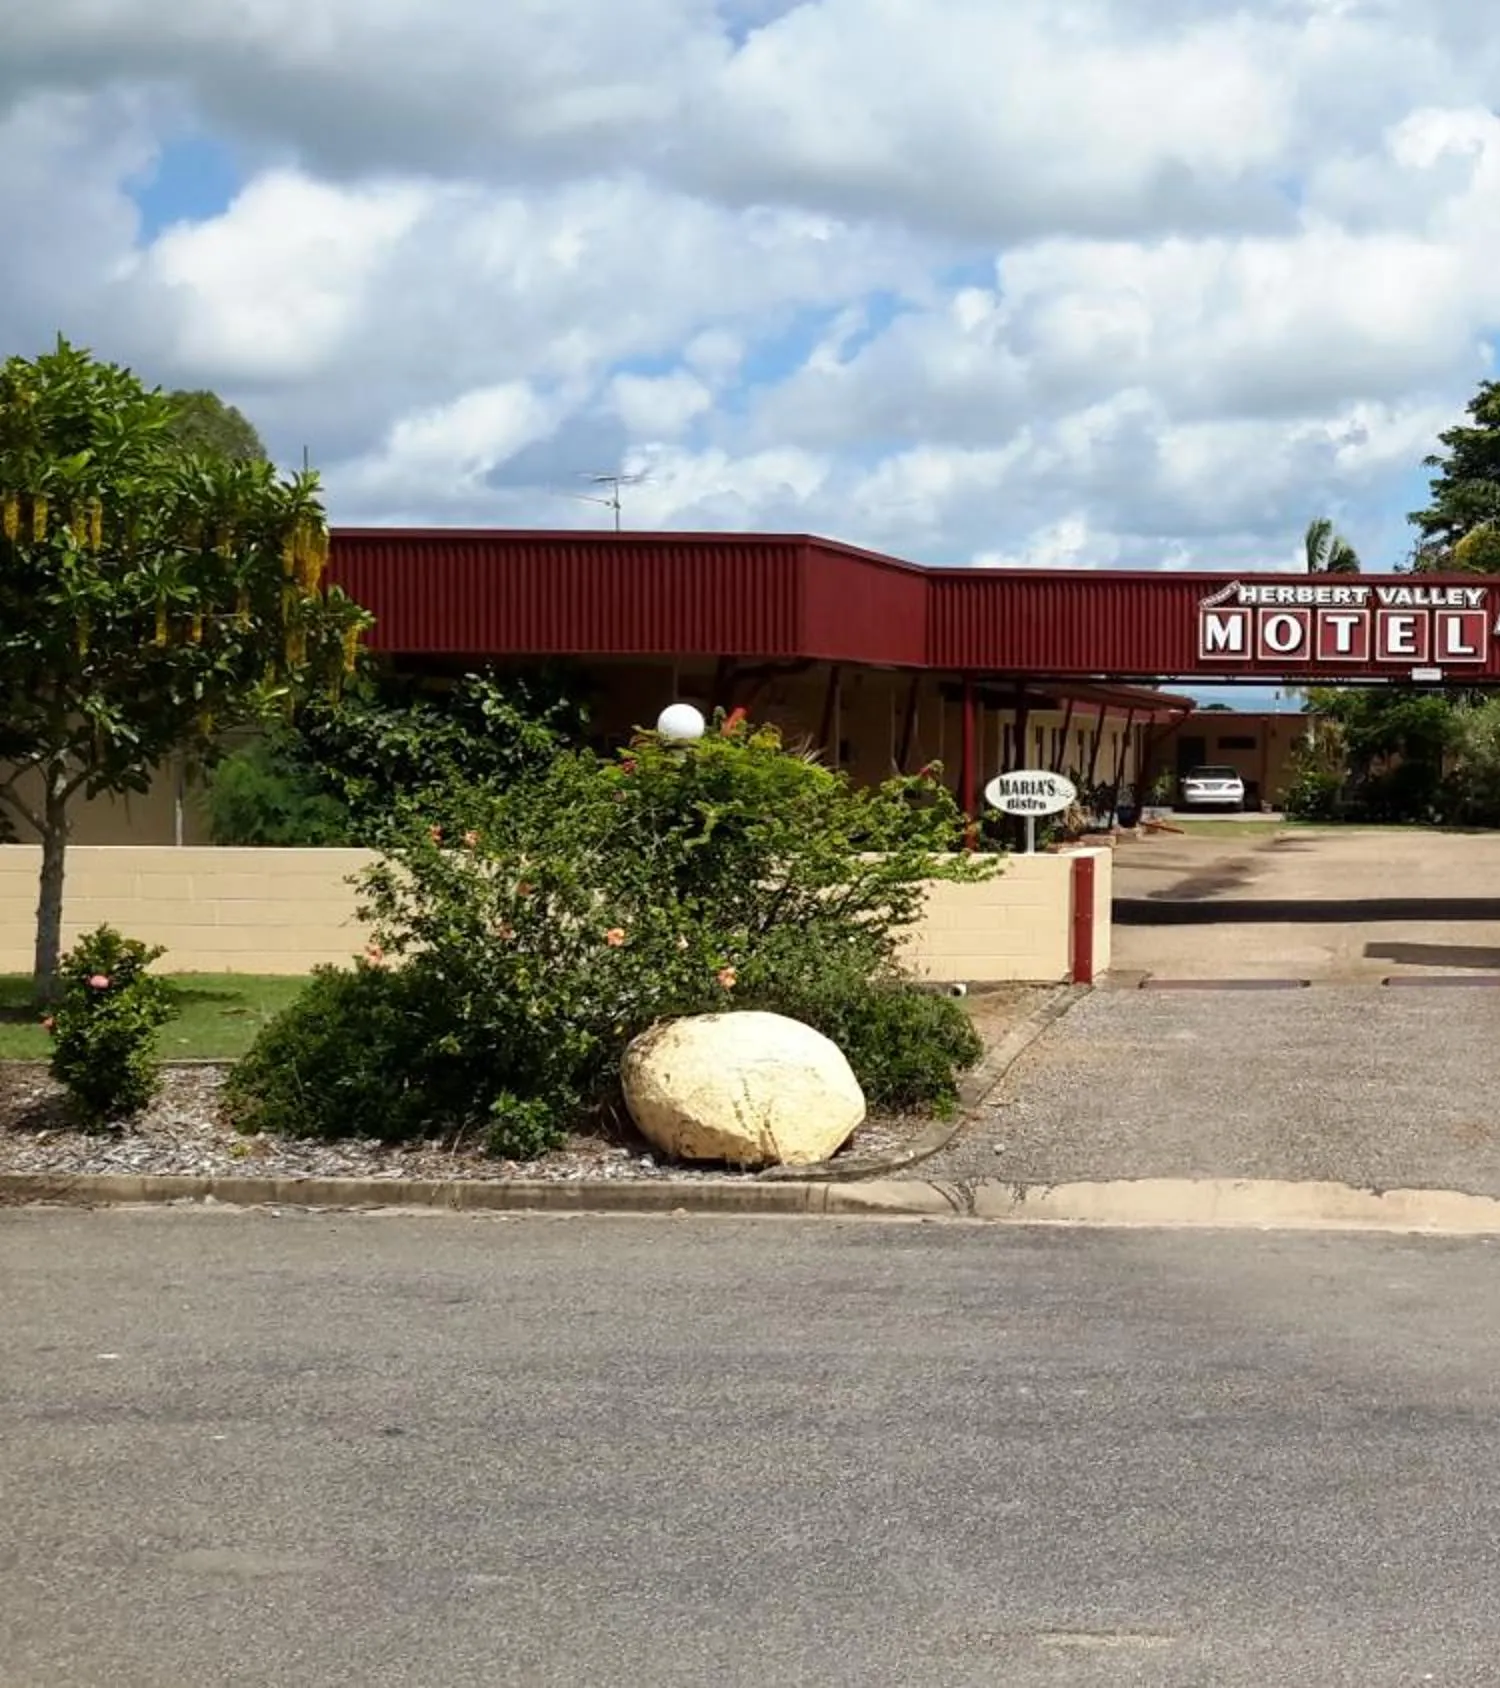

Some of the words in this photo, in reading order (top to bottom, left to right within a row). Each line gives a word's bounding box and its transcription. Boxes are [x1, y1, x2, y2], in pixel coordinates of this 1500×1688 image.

[1238, 585, 1369, 606] HERBERT
[1376, 586, 1486, 607] VALLEY
[1205, 614, 1475, 654] MOTEL
[999, 778, 1056, 798] MARIA'S
